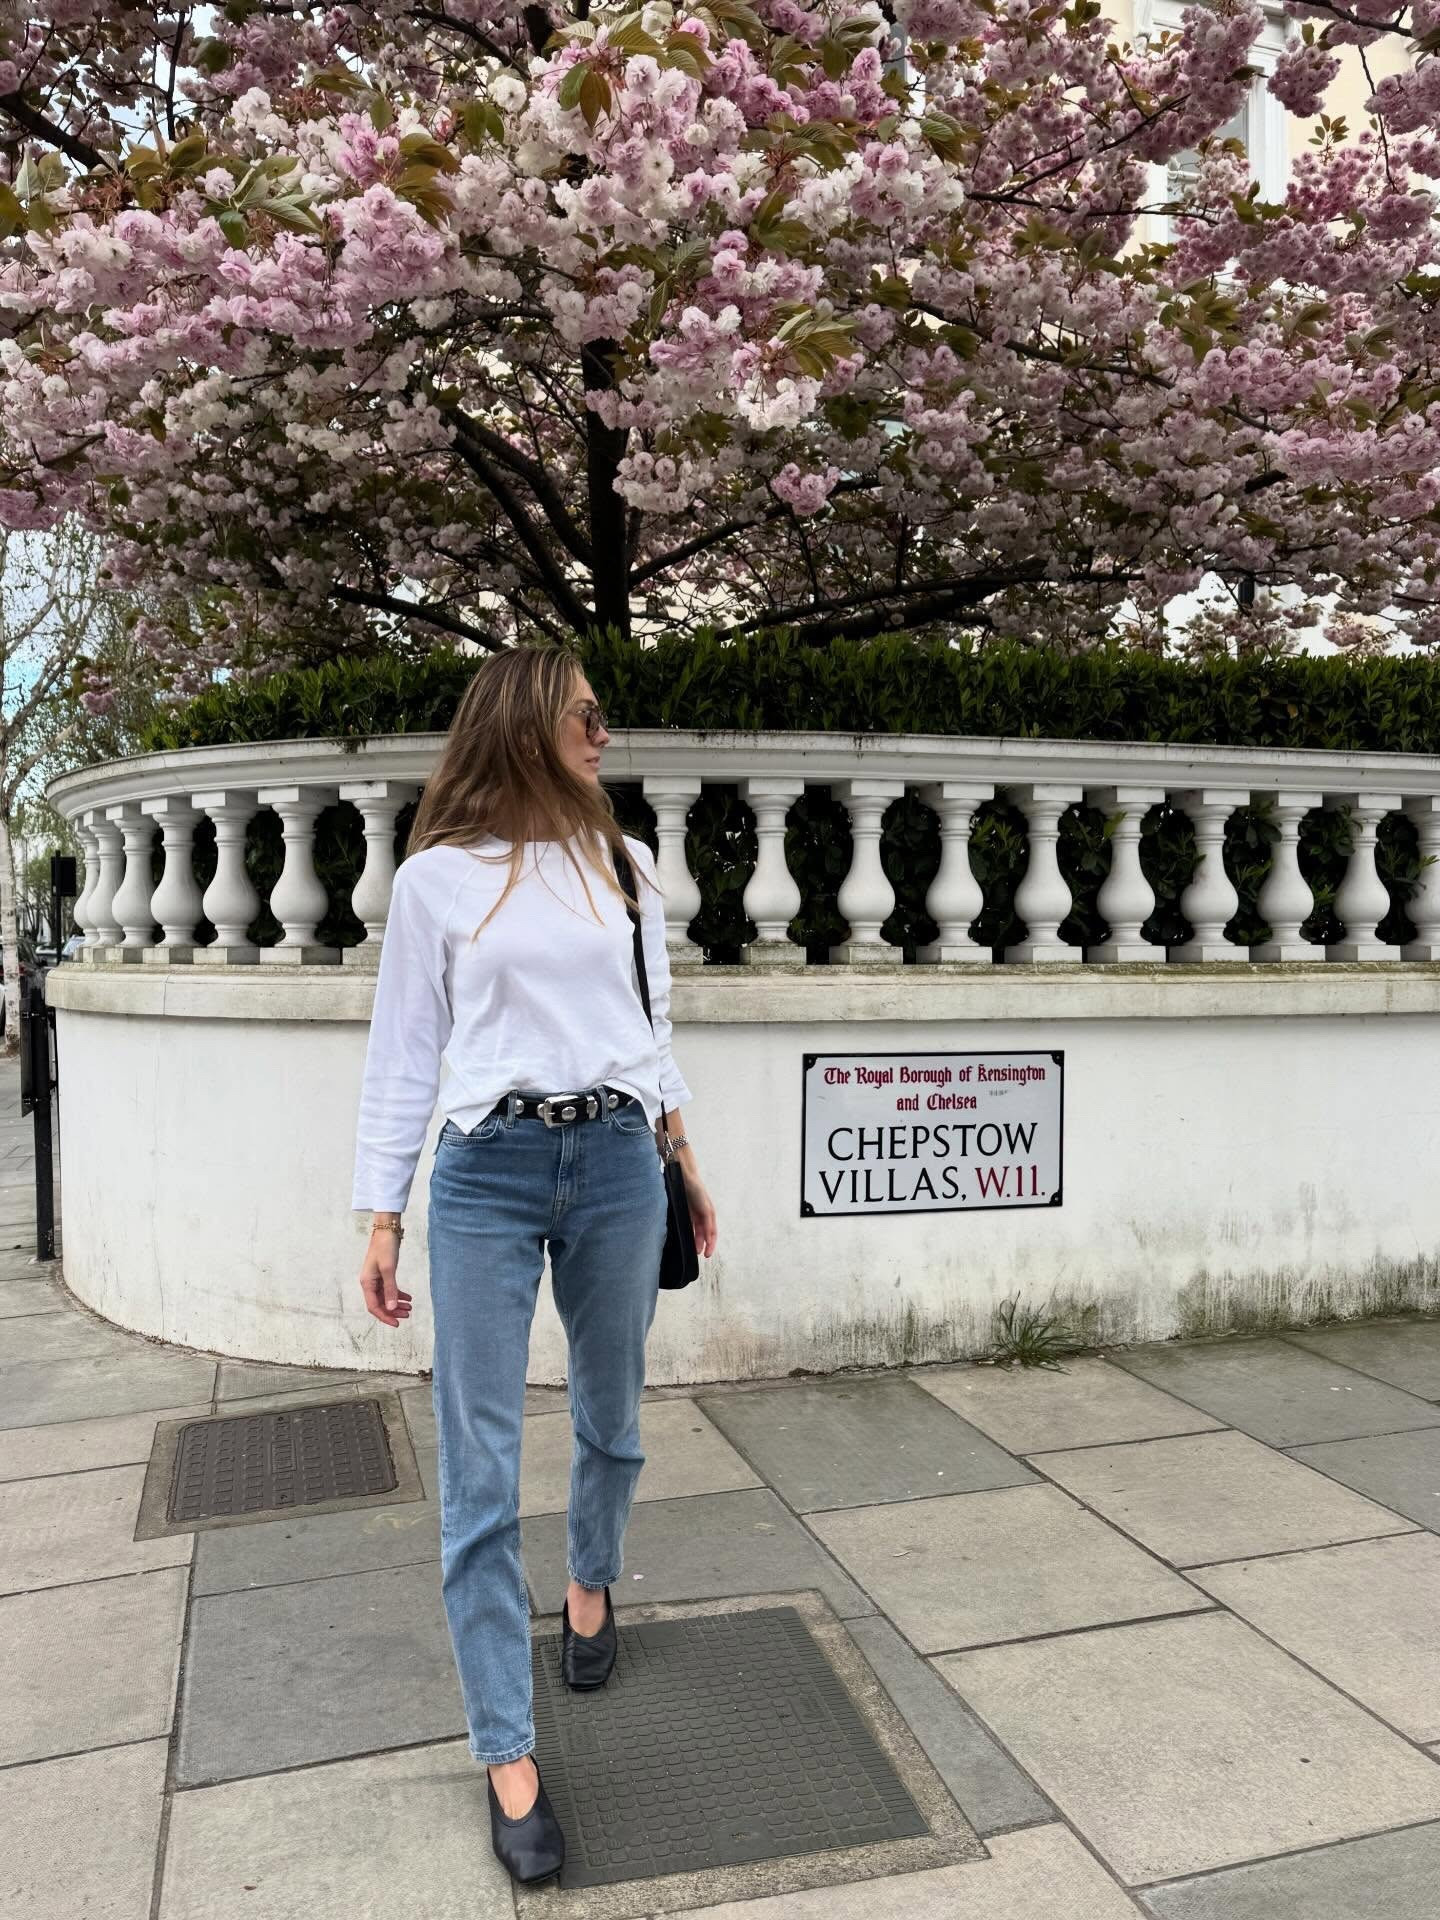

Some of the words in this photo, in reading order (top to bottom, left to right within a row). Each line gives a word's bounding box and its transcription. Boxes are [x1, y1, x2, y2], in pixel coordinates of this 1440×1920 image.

[824, 1067, 851, 1084] The
[855, 1066, 893, 1089] Royal
[900, 1066, 952, 1088] Borough
[959, 1065, 973, 1083] of
[978, 1064, 1046, 1086] Kensington
[896, 1094, 919, 1111] and
[927, 1093, 977, 1110] Chelsea
[828, 1122, 1038, 1161] CHEPSTOW
[819, 1166, 967, 1204] VILLAS,
